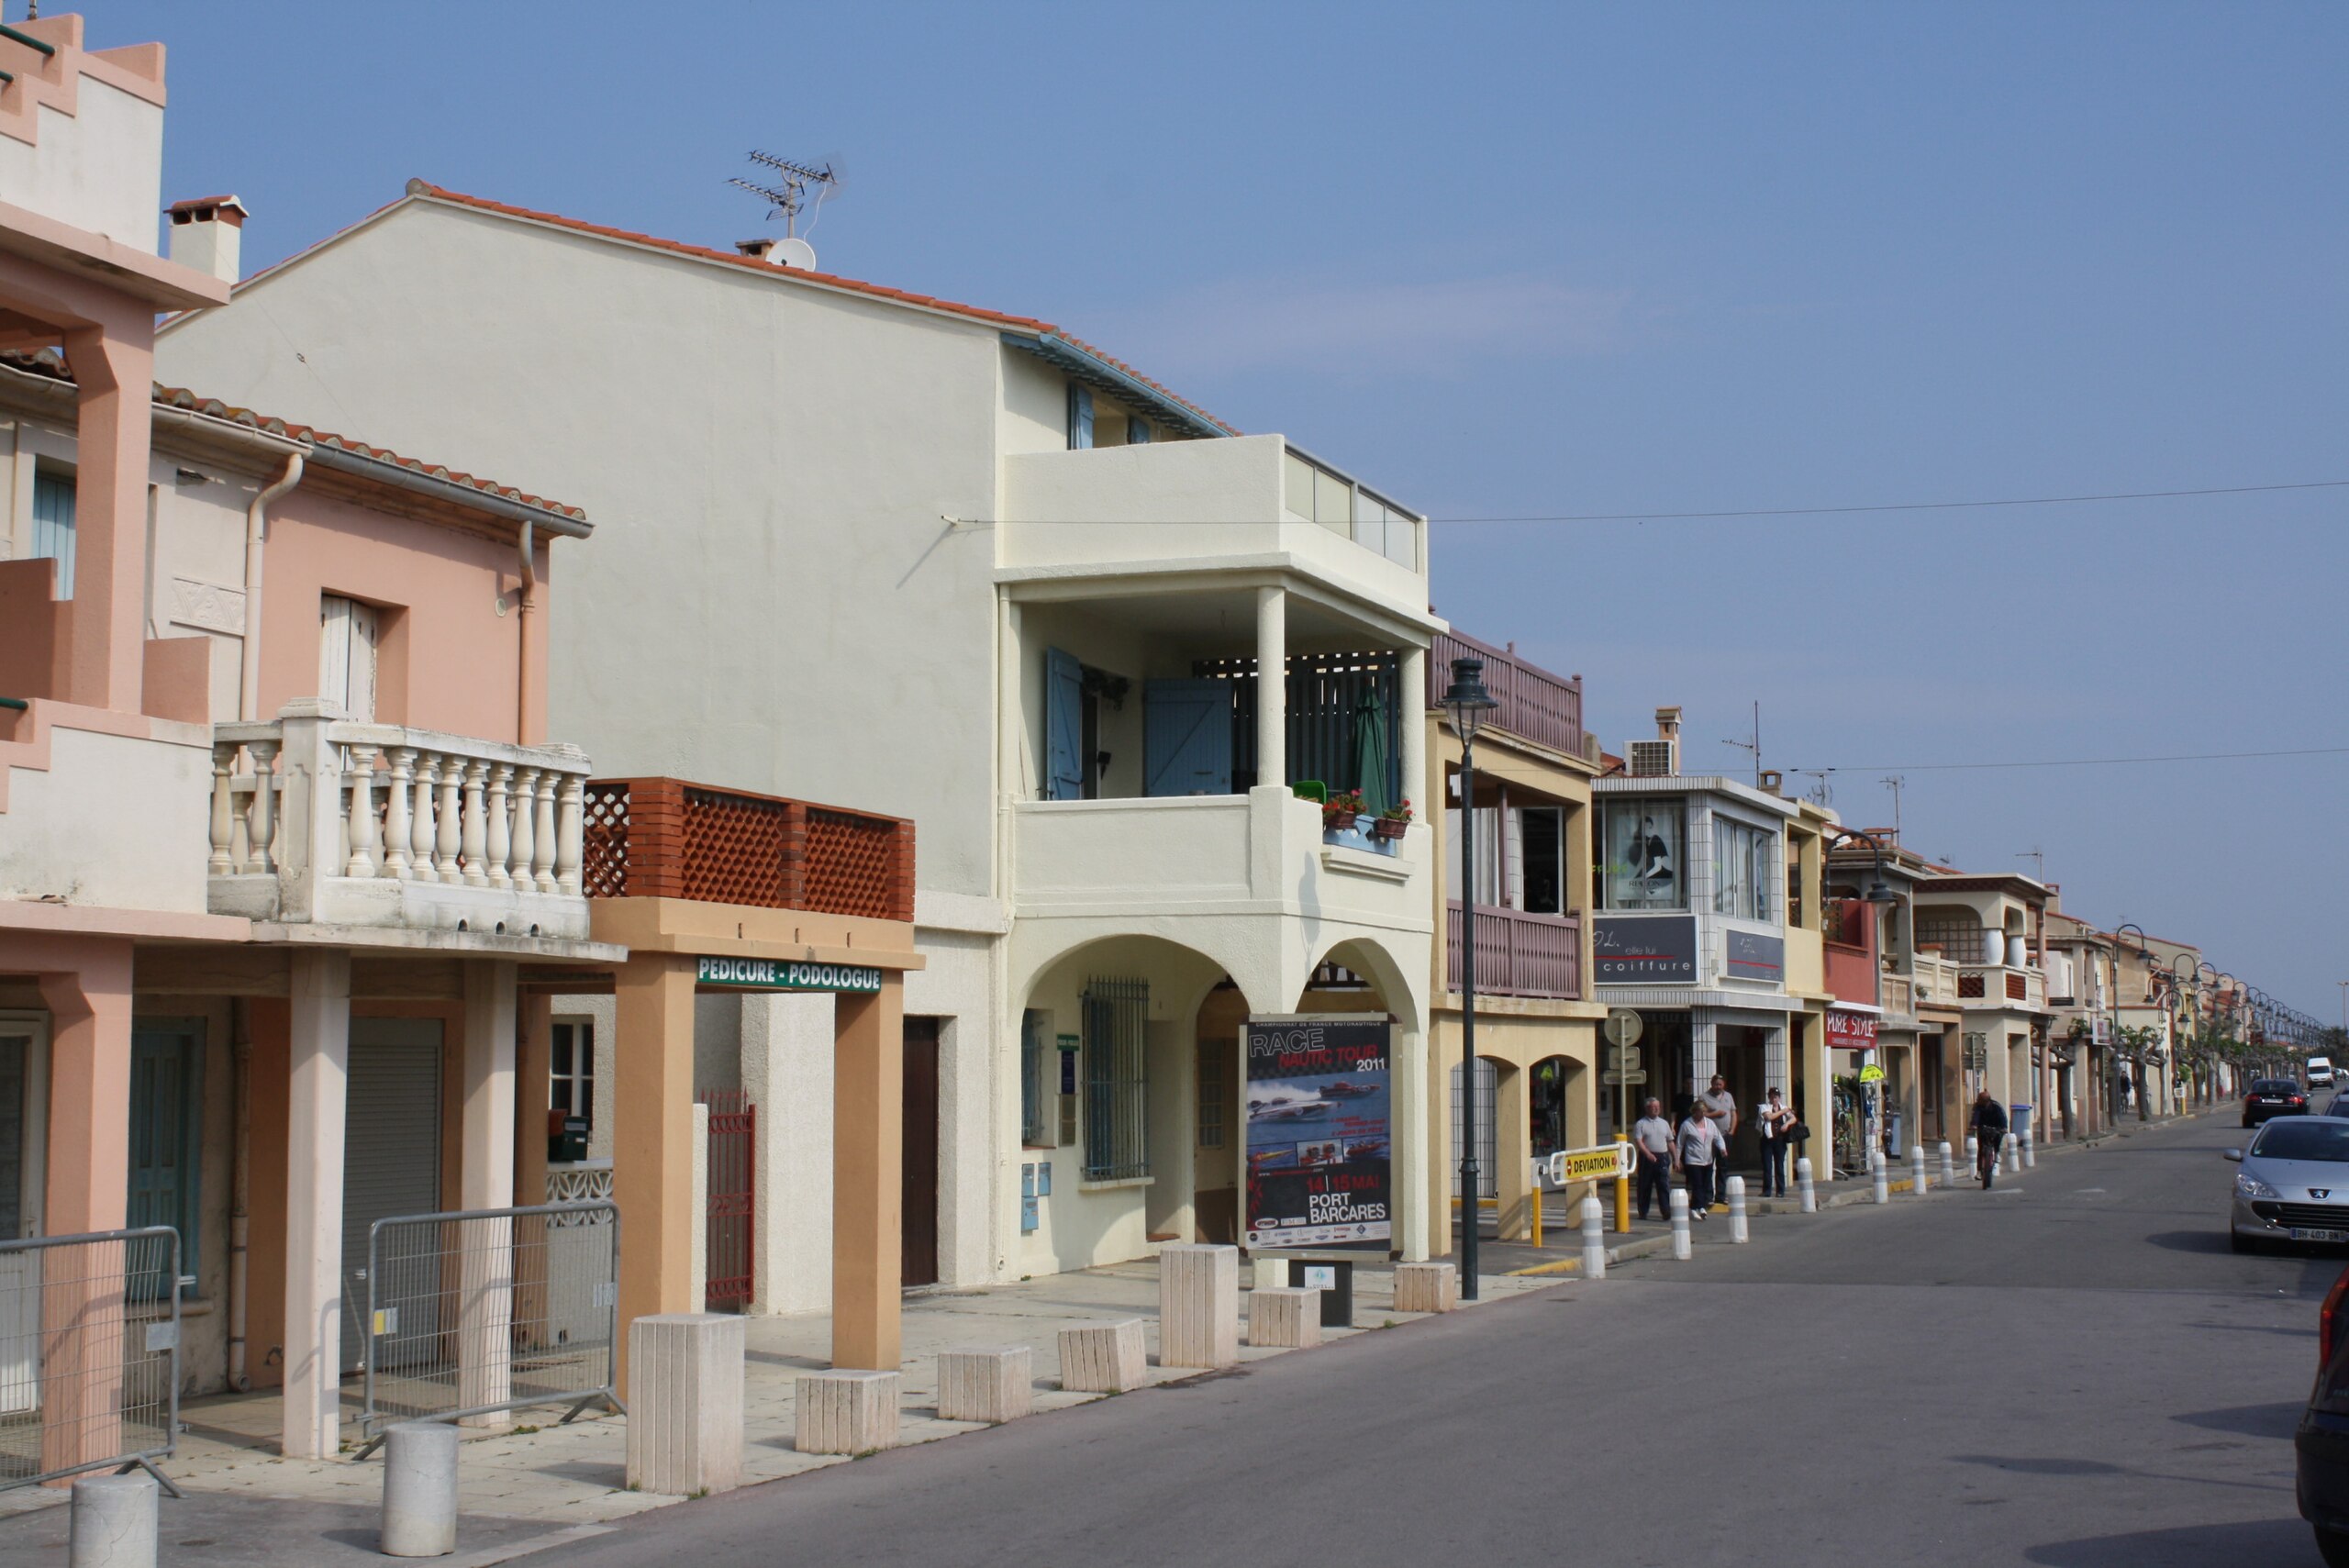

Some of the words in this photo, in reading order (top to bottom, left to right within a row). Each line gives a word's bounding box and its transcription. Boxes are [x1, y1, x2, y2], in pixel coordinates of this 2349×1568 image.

[1629, 880, 1659, 888] REVON
[699, 958, 774, 983] PEDICURE
[789, 963, 880, 989] PODOLOGUE
[1603, 961, 1690, 972] coiffure
[1827, 1011, 1847, 1034] PURE
[1852, 1014, 1874, 1038] STYLE
[1249, 1028, 1325, 1058] RACE
[1278, 1048, 1334, 1069] NAUTIC
[1336, 1043, 1378, 1062] TOUR
[1356, 1057, 1386, 1073] 2011
[1574, 1156, 1610, 1173] DEVIATION
[1307, 1176, 1325, 1193] 14
[1332, 1174, 1350, 1191] 15
[1353, 1173, 1380, 1190] MAI
[1309, 1193, 1351, 1208] PORT
[1310, 1203, 1386, 1224] BARCARES
